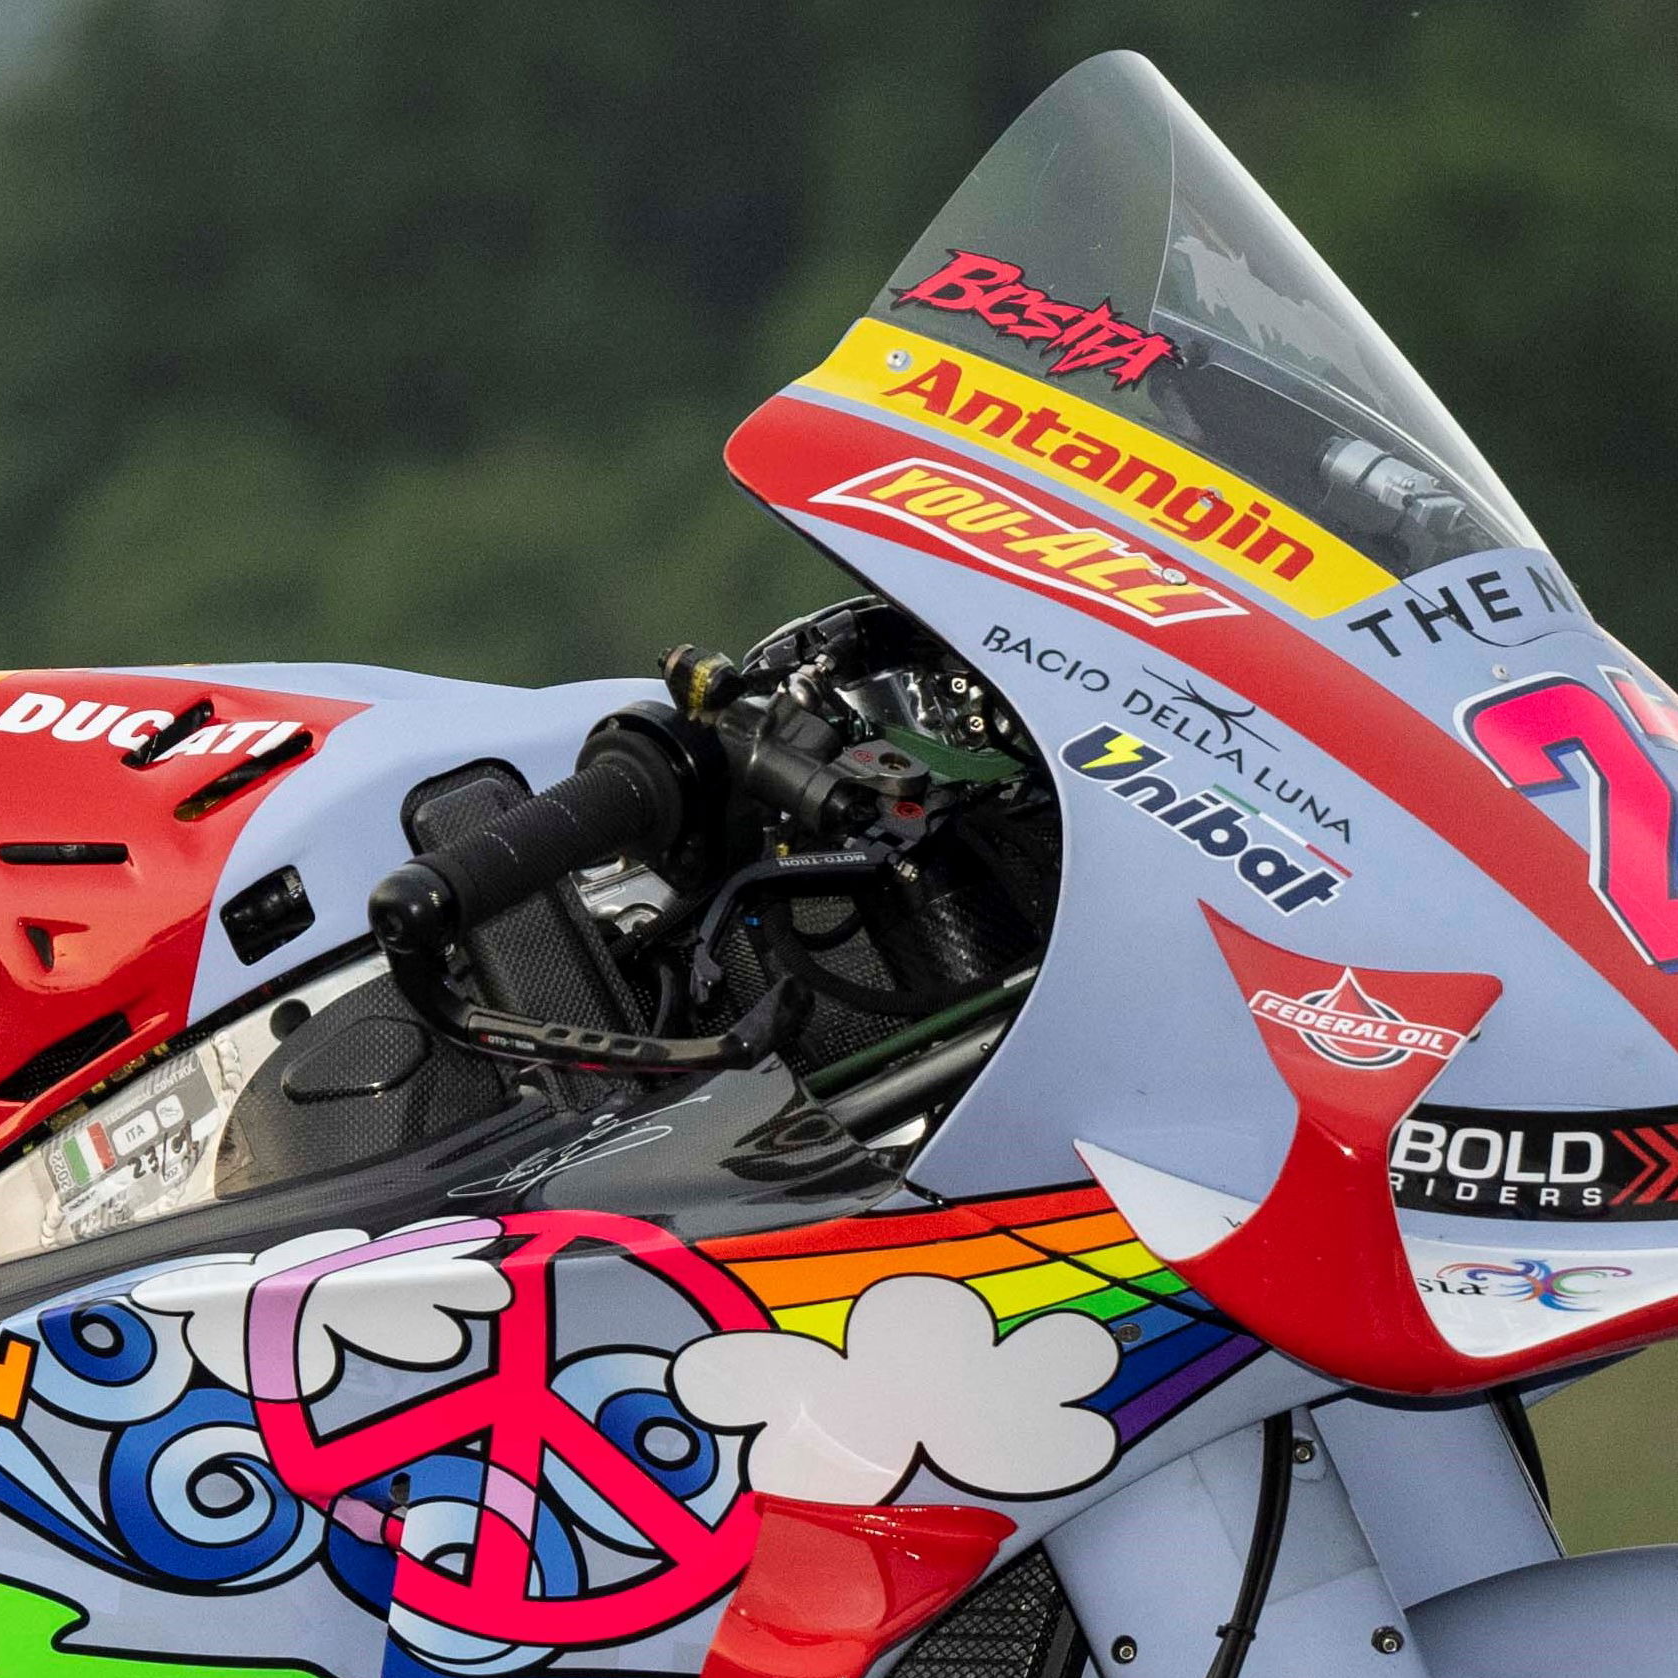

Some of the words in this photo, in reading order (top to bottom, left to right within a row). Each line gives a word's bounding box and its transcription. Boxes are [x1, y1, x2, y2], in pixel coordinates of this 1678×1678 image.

[883, 358, 1314, 582] Antangin
[1346, 570, 1523, 658] THE
[1525, 564, 1584, 616] N
[982, 625, 1110, 693] BACIO
[1121, 688, 1245, 775] DELLA
[1253, 766, 1352, 844] LUNA
[1058, 721, 1346, 917] Unibat
[1261, 998, 1391, 1042] FEDERAL
[1396, 1029, 1445, 1051] OIL
[125, 1124, 146, 1144] ITA
[1390, 1118, 1604, 1184] BOLD
[1389, 1172, 1603, 1207] RIDERS
